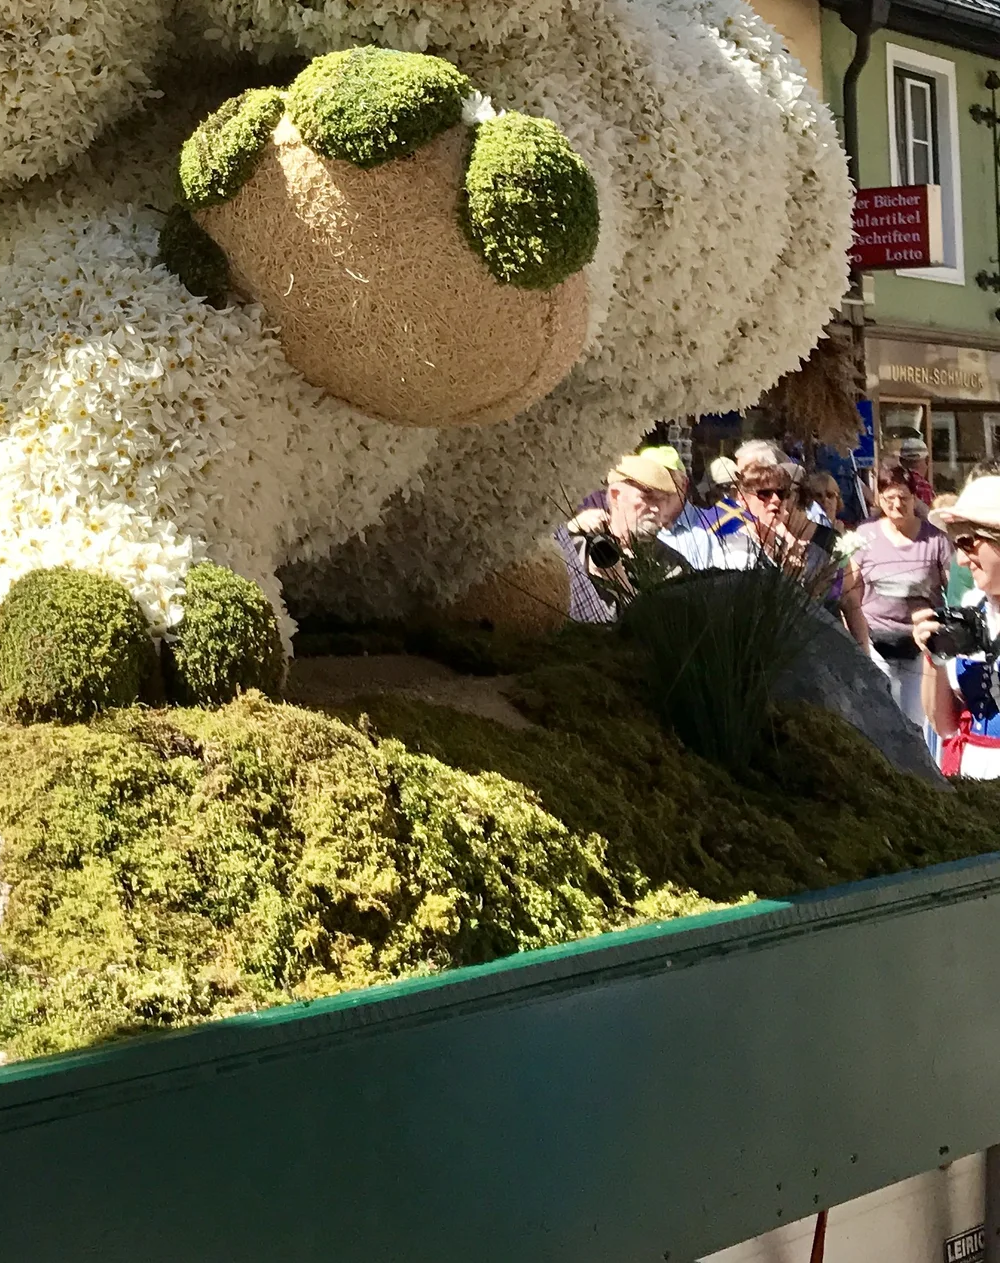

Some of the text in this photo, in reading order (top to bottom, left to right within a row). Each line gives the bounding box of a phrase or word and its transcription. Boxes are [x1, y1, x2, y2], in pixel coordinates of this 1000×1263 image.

[874, 193, 921, 209] Bücher
[853, 210, 921, 228] ulartikel
[885, 248, 923, 262] Lotto
[891, 364, 984, 389] UHREN-SCHMUCK
